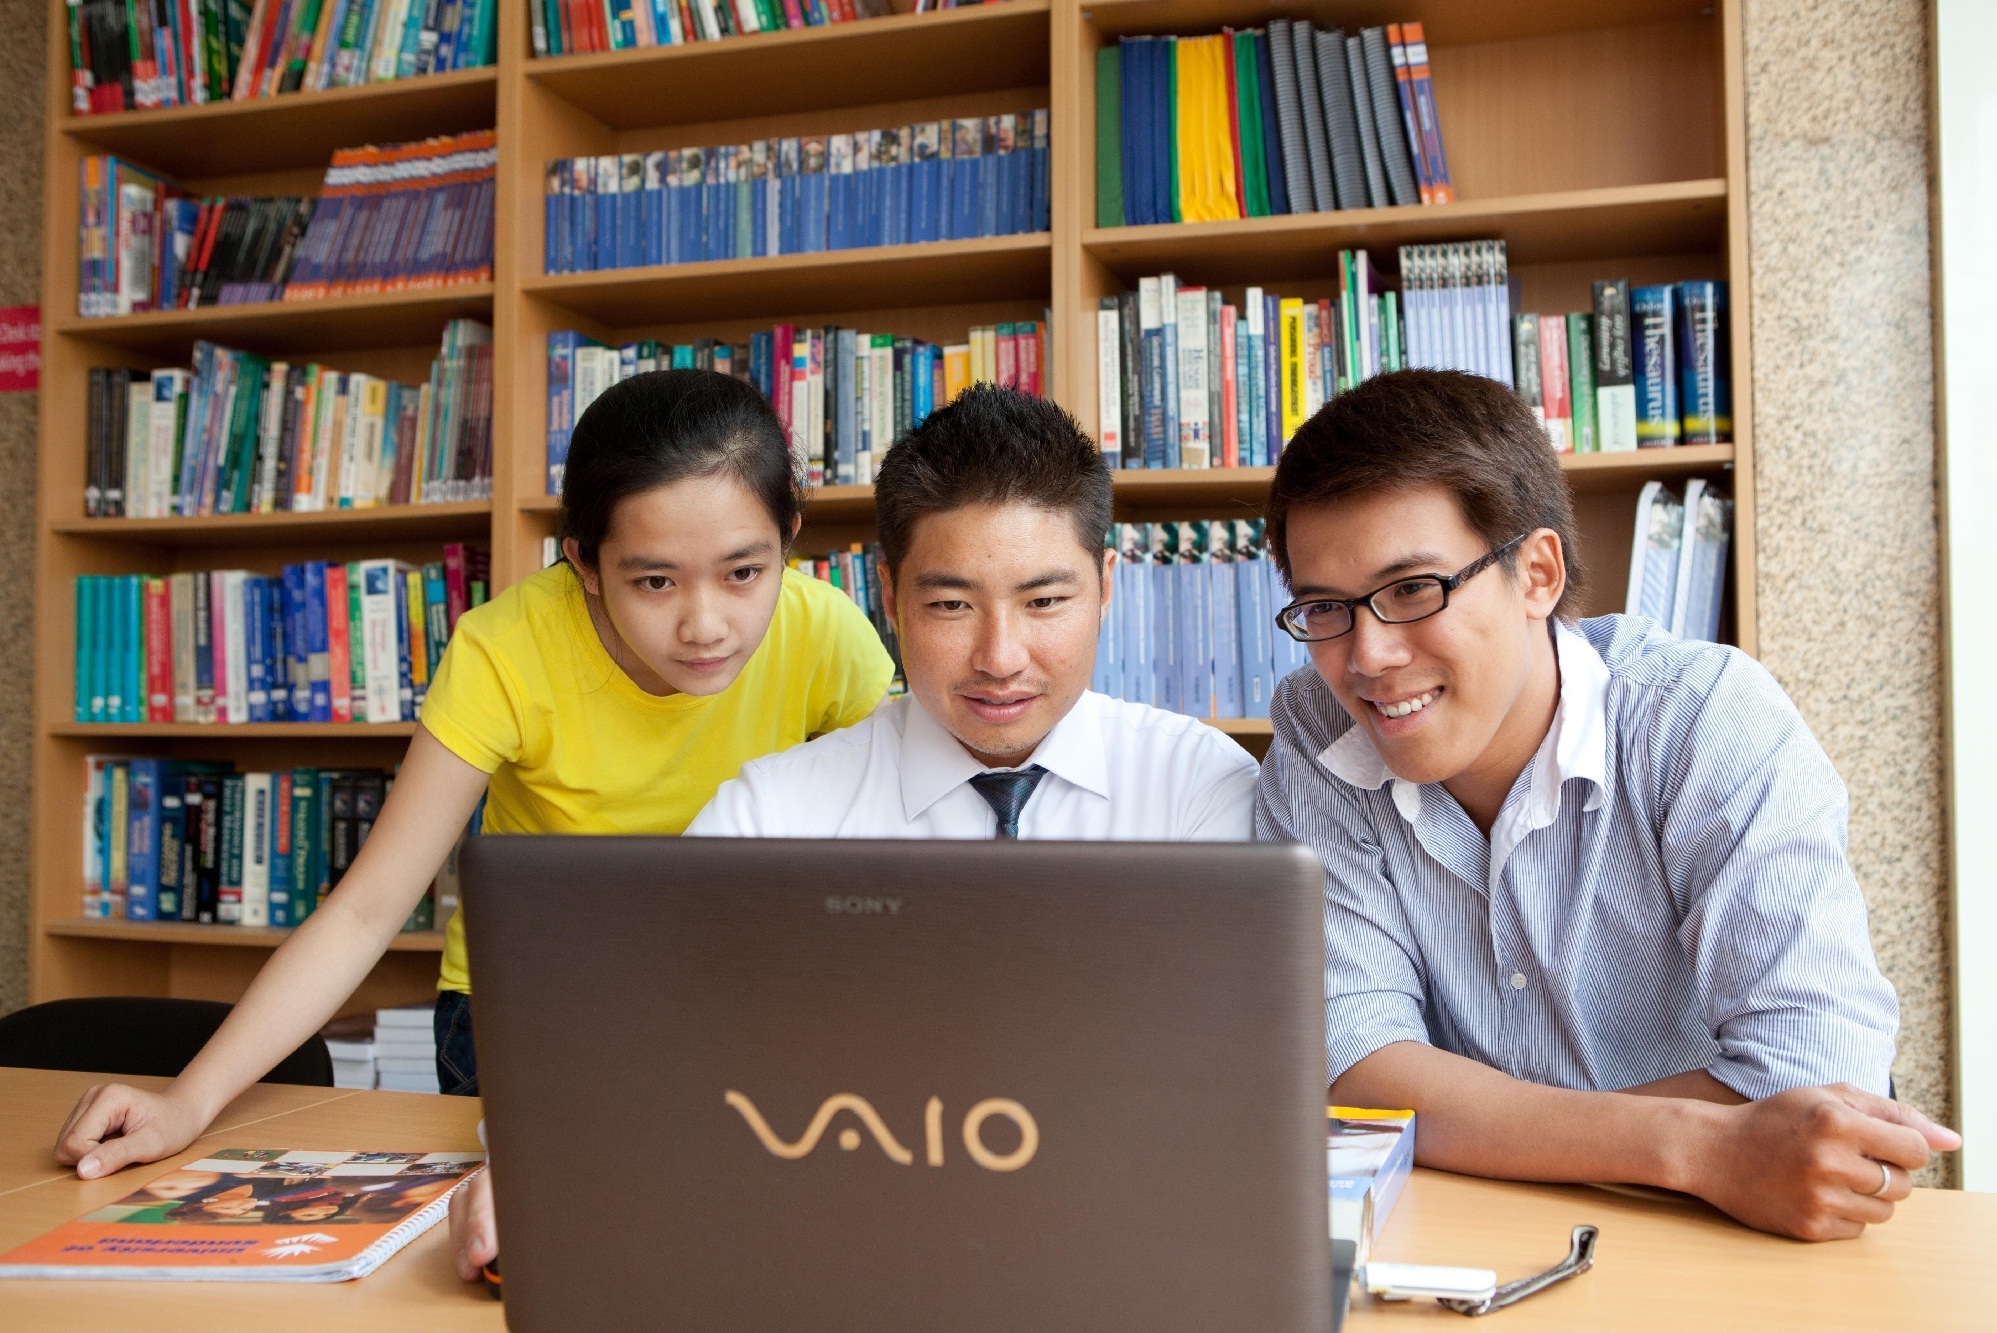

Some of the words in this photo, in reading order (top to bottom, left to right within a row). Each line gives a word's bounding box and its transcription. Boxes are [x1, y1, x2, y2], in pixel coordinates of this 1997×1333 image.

[1643, 315, 1669, 426] Thesaurus
[1694, 310, 1718, 422] Thesaurus
[825, 896, 902, 913] SONY
[724, 1090, 1039, 1171] VAIO
